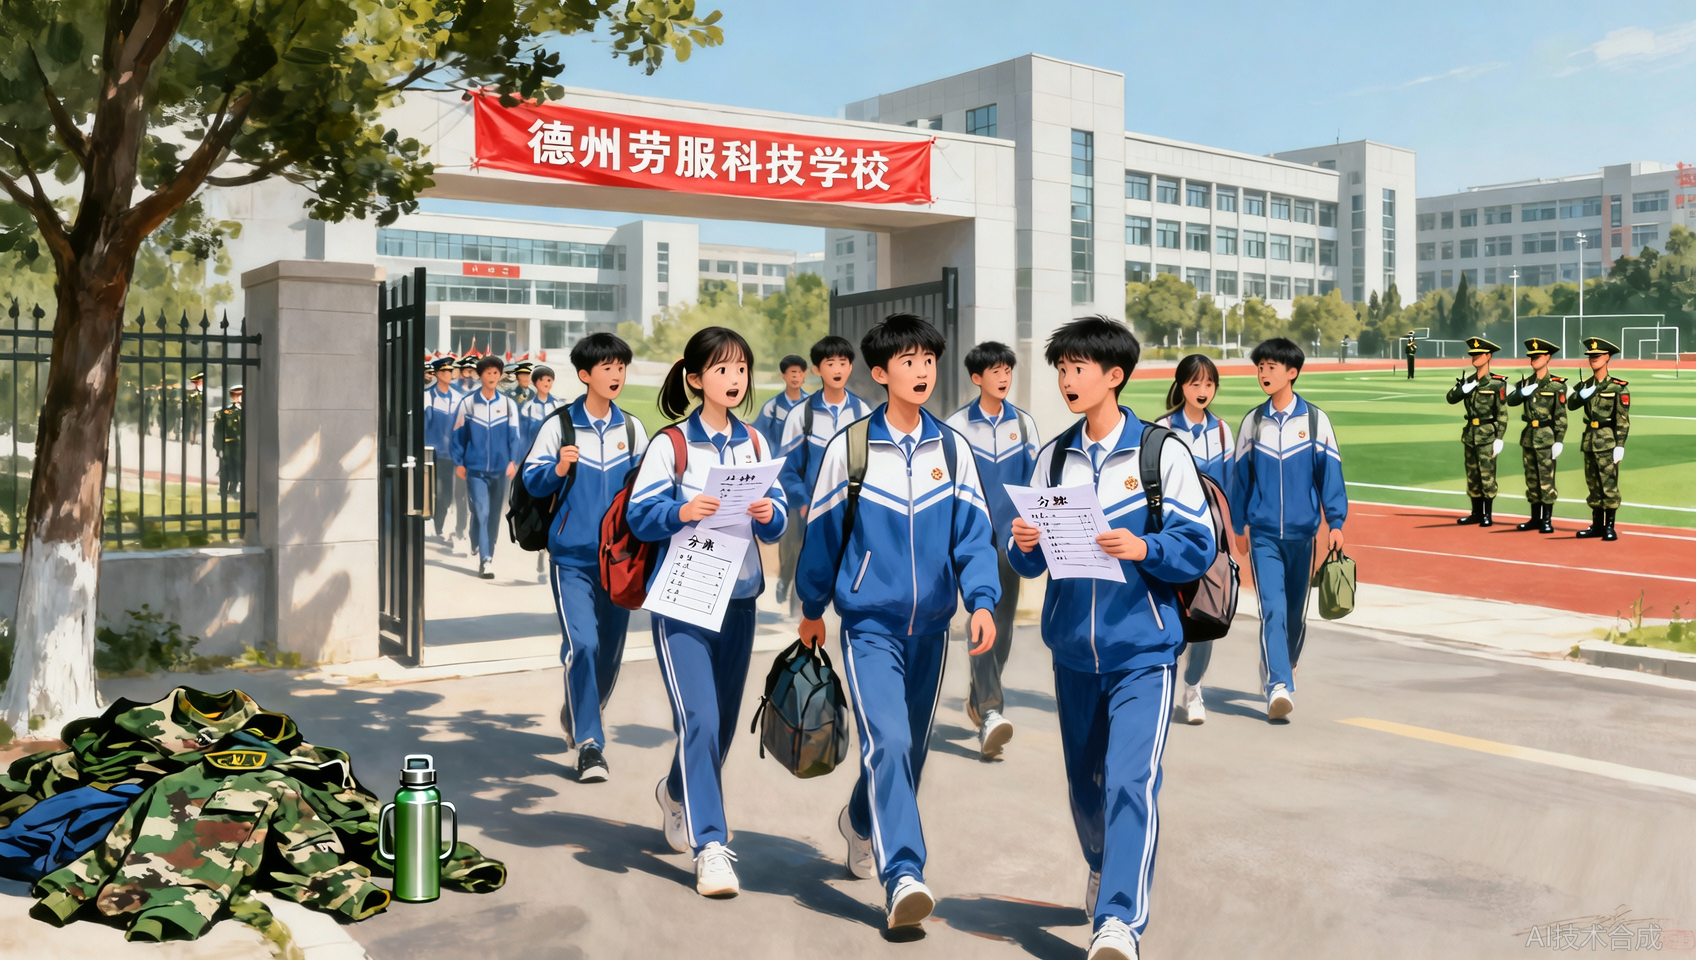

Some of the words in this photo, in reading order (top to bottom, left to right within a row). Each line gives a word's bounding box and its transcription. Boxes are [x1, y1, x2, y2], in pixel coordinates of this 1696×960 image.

[527, 118, 891, 191] 德州劳服科技学校
